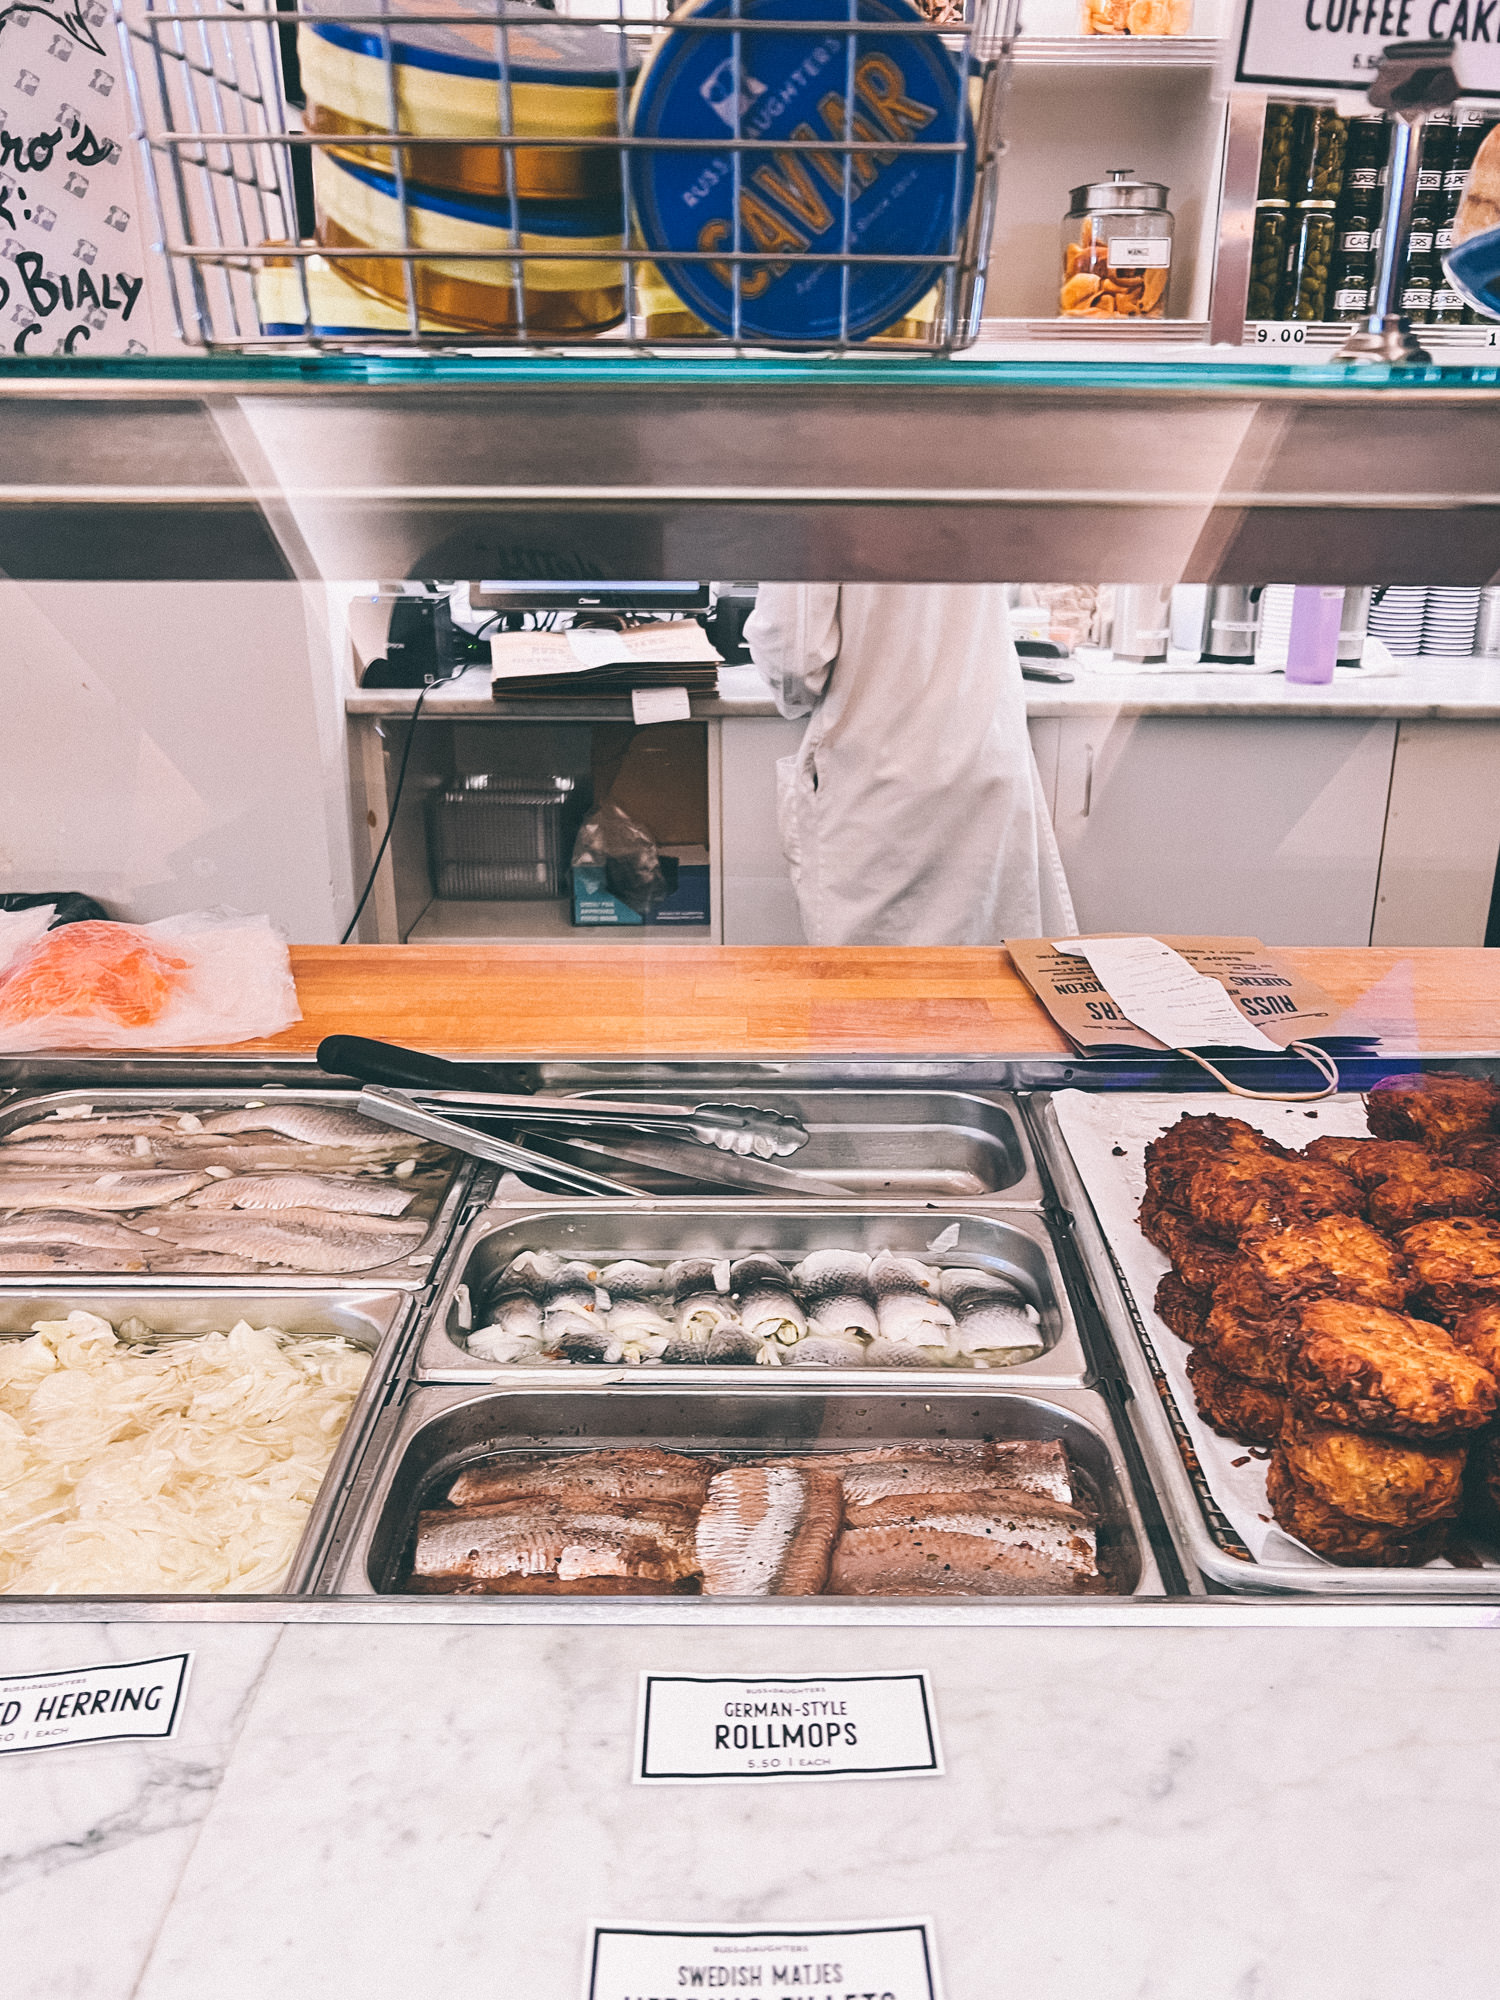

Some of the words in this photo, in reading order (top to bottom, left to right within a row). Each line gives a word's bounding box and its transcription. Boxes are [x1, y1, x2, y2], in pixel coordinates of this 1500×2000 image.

[1306, 0, 1411, 36] COFFEE
[1429, 0, 1500, 43] CAK
[698, 52, 938, 300] CAVIAR
[15, 251, 143, 321] BIALY
[1258, 329, 1304, 343] 9.00
[1229, 975, 1293, 987] QUEENS
[1239, 995, 1298, 1017] RUSS
[34, 1685, 164, 1723] HERRING
[724, 1700, 848, 1718] GERMAN-STYLE
[36, 1727, 70, 1738] EACH
[715, 1722, 858, 1750] ROLLMOPS
[747, 1758, 781, 1769] 5.50
[799, 1757, 831, 1767] EACH
[678, 1964, 762, 1988] SWEDISH
[771, 1963, 844, 1986] MATJES
